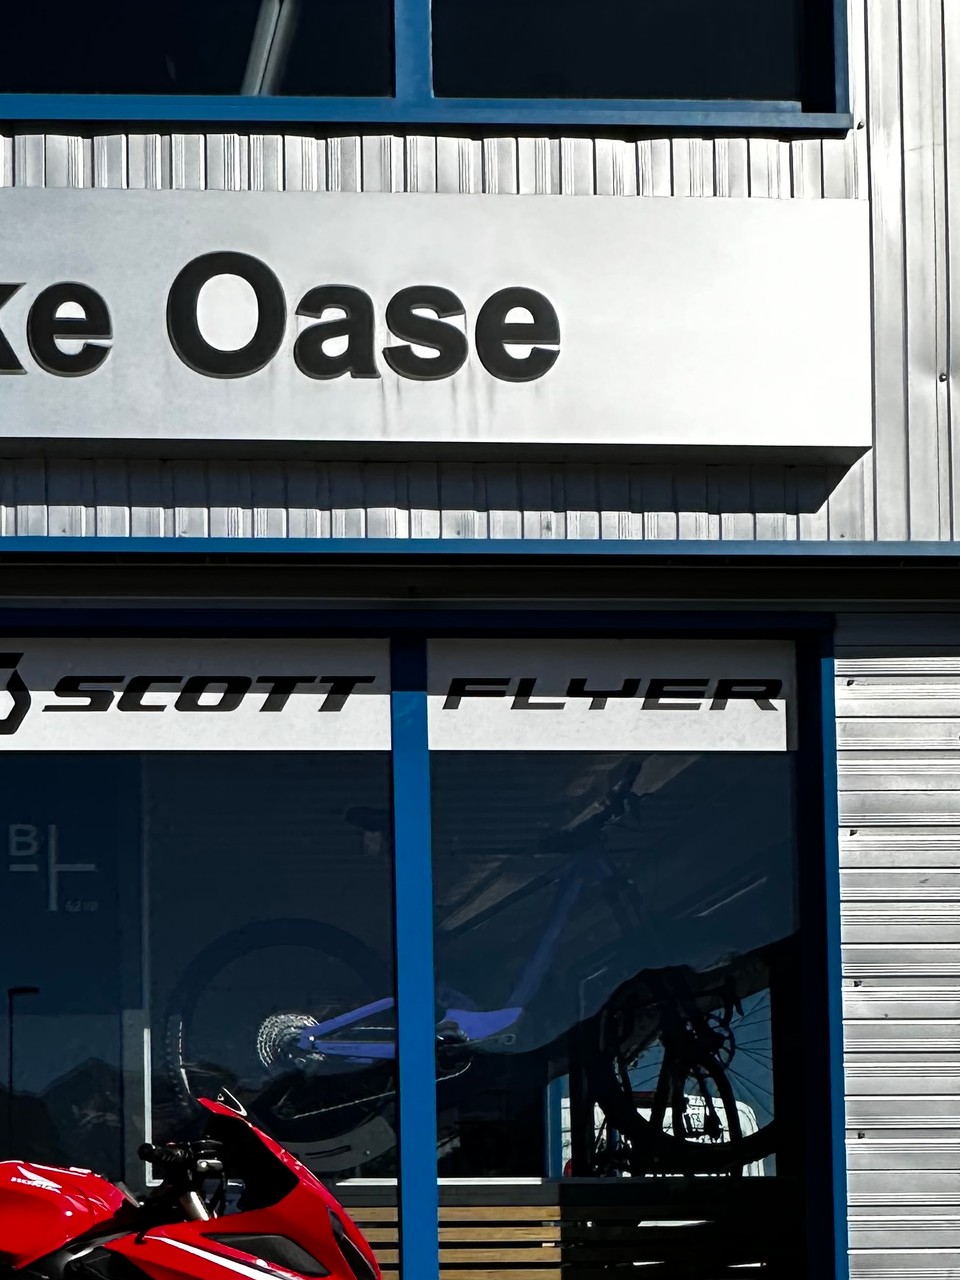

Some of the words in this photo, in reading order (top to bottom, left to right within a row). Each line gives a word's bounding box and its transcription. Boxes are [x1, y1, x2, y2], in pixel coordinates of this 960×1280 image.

[166, 250, 561, 383] Oase
[43, 675, 375, 713] SCOTT
[442, 677, 782, 711] FLYER
